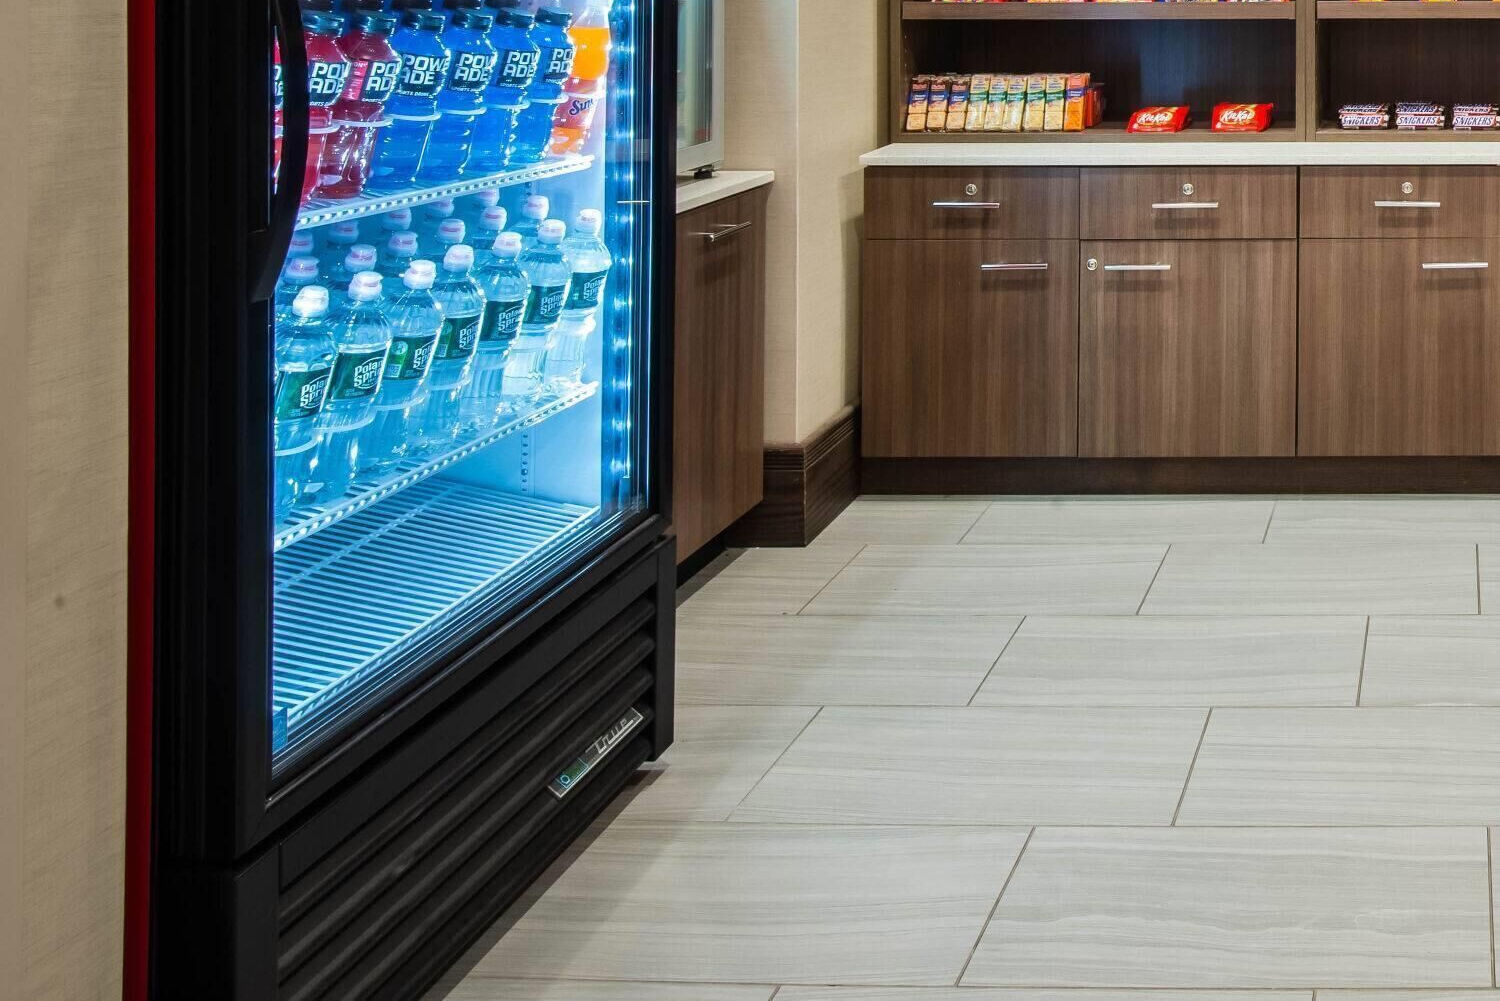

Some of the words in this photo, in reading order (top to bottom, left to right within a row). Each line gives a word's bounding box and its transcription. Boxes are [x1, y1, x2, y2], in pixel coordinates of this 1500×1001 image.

[455, 67, 489, 81] ADE
[1342, 116, 1380, 125] SNICKERS
[1398, 116, 1436, 125] SNICKERS
[1454, 116, 1492, 126] SNICKERS
